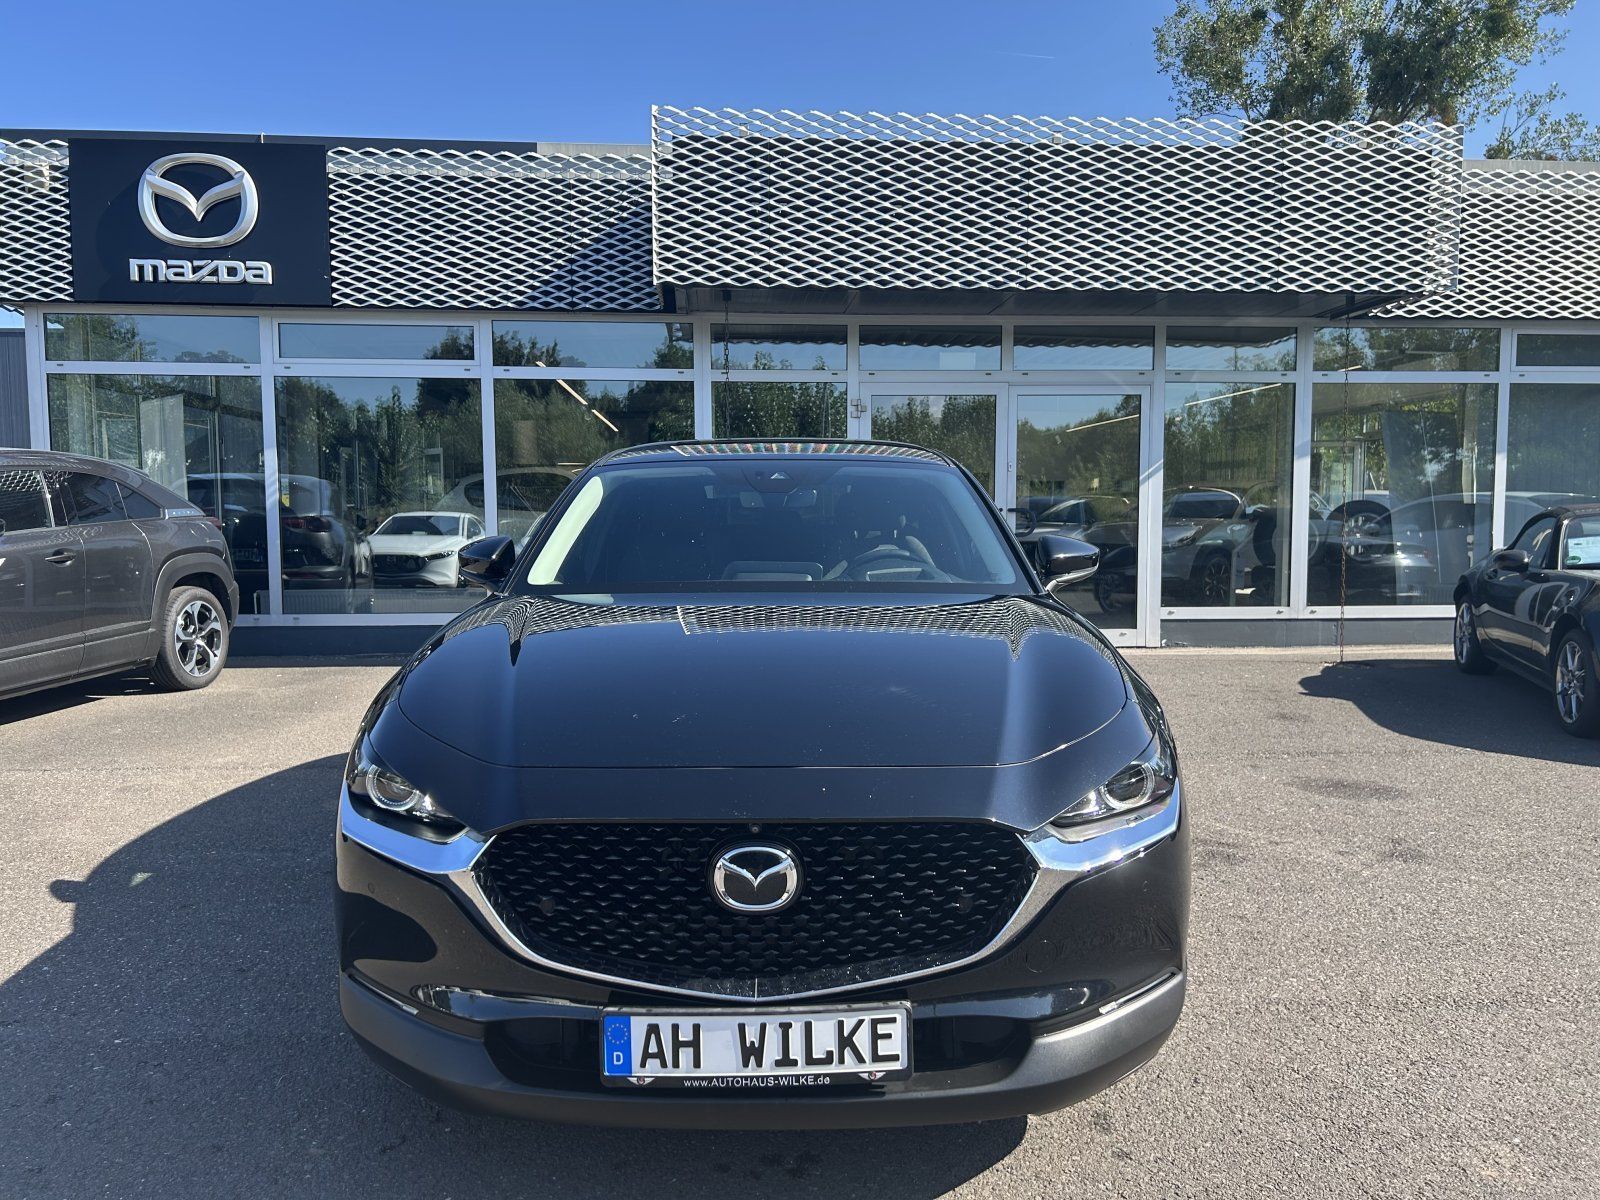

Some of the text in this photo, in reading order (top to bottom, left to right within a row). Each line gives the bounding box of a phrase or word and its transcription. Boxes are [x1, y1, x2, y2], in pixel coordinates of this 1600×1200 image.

[640, 1016, 900, 1069] AH WILKE
[613, 1051, 624, 1065] D
[683, 1075, 831, 1088] www.AUTOHAUS-WILKE.de
